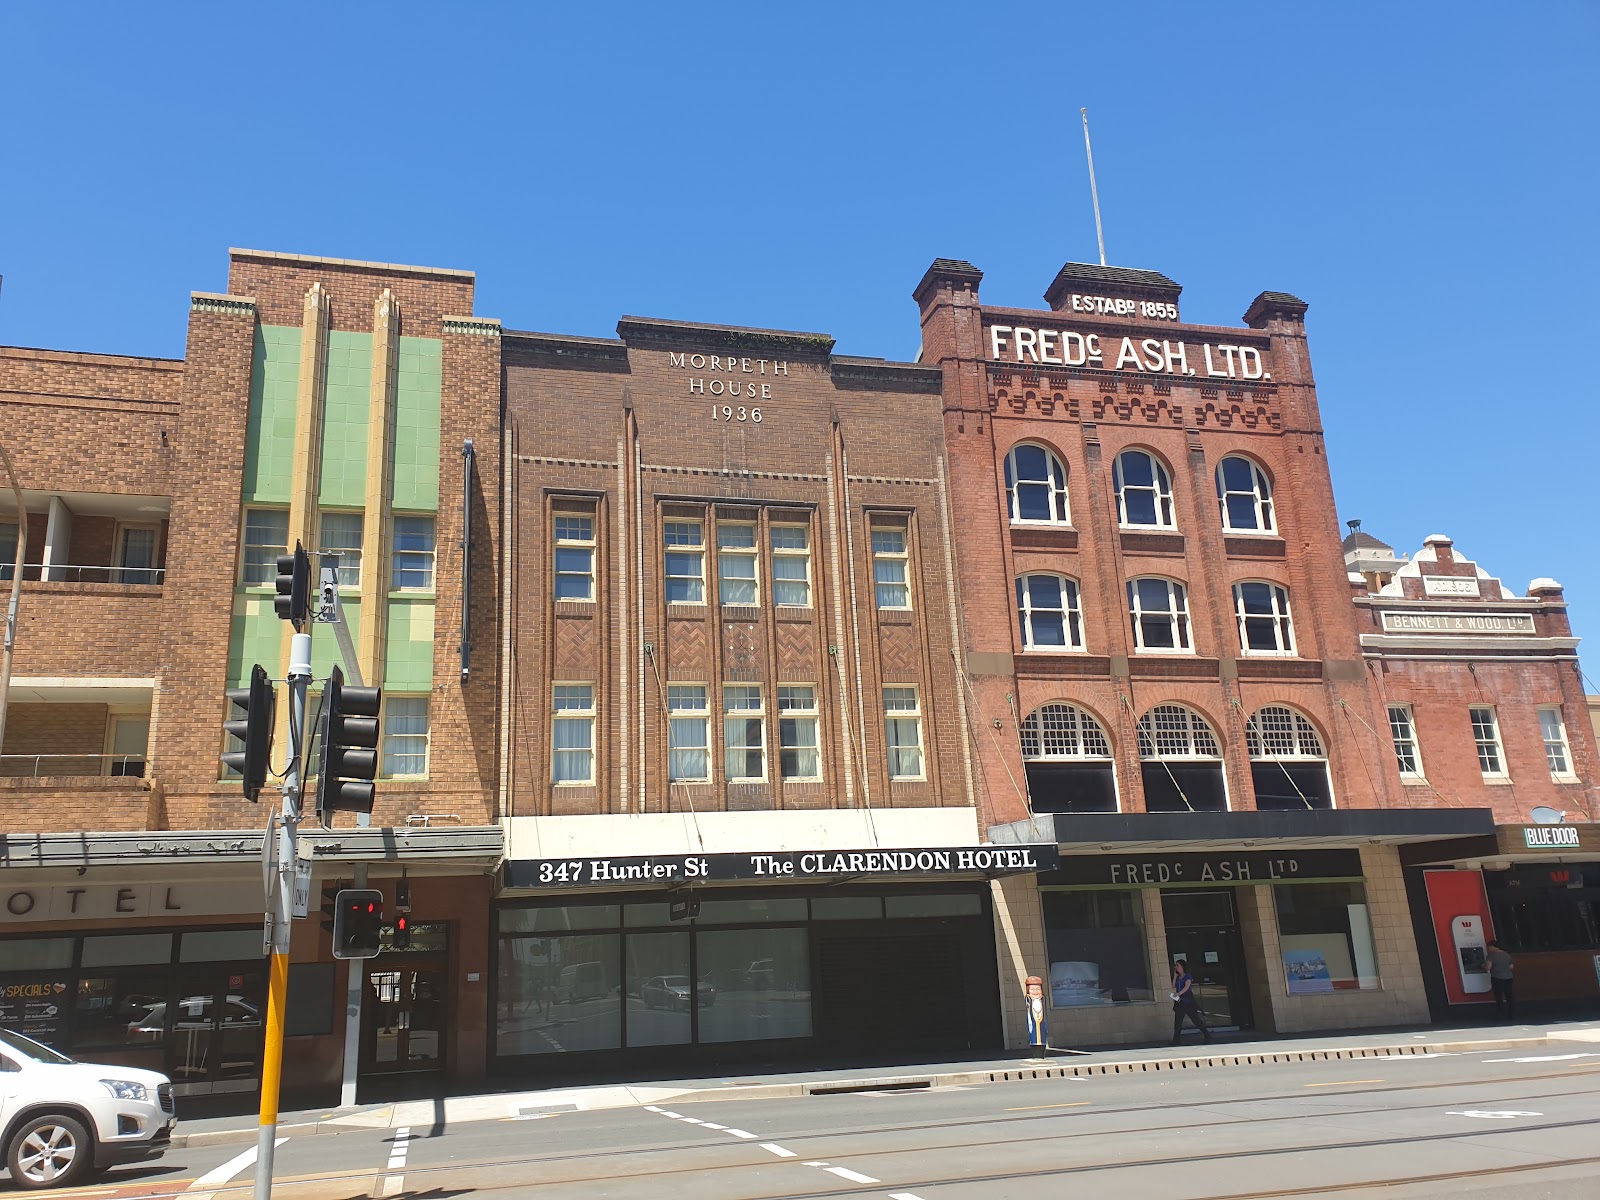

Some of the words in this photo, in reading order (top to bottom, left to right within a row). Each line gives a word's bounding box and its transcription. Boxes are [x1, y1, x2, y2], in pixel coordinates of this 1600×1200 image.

[1140, 300, 1177, 319] 1855
[669, 352, 788, 376] MORPETH
[1116, 336, 1196, 377] ASH,
[1203, 343, 1271, 380] LTD.
[690, 378, 772, 399] HOUSE
[712, 404, 763, 423] 1936
[1393, 615, 1449, 628] BENNETT
[1455, 617, 1463, 629] &
[1527, 828, 1553, 845] BLUE
[1552, 827, 1580, 844] DOOR
[539, 861, 583, 882] 347
[590, 860, 677, 880] Hunter
[684, 857, 709, 877] St
[750, 855, 794, 875] The
[800, 850, 951, 873] CLARENDON
[957, 849, 1037, 869] HOTEL
[1201, 861, 1250, 881] ASH
[1268, 859, 1299, 879] LTD
[6, 887, 182, 916] OTEL
[6, 984, 51, 998] SPECIALS
